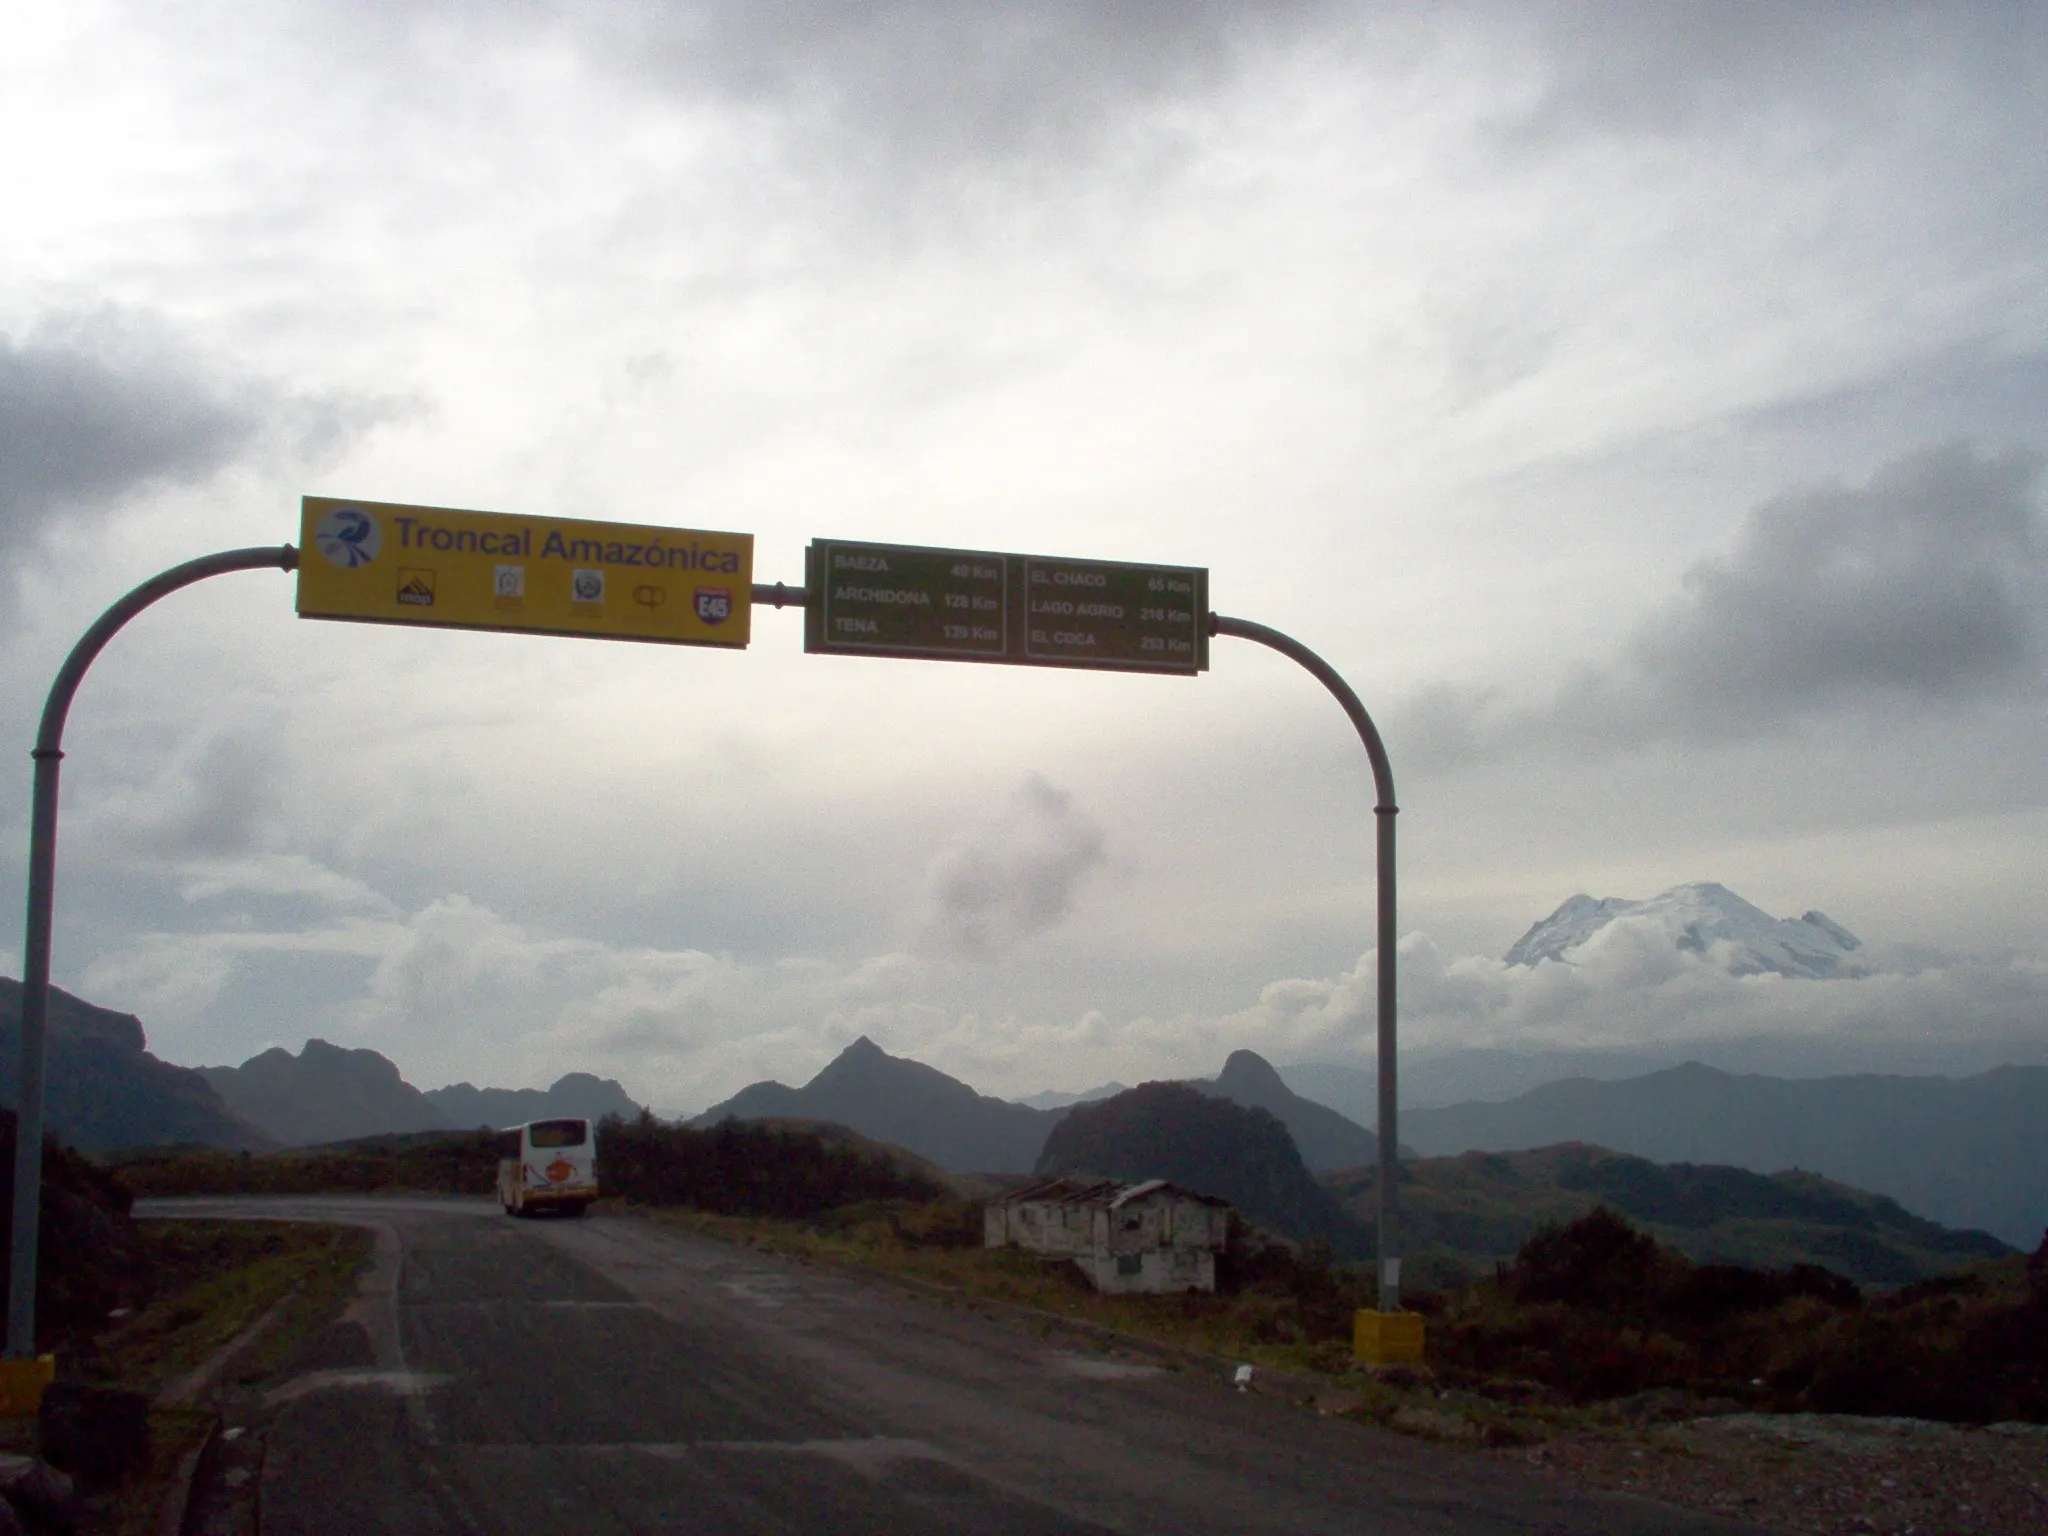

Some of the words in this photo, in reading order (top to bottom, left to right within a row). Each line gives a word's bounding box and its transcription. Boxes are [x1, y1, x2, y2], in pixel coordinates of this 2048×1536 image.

[394, 517, 531, 557] Troncal
[540, 527, 740, 574] Amazónica
[835, 555, 888, 572] BAEZA
[973, 566, 997, 581] Km
[1032, 570, 1049, 584] EL
[1054, 572, 1106, 587] CHACO
[1168, 580, 1190, 594] Km
[698, 596, 728, 617] E45
[835, 587, 930, 605] ARCHIDONA
[973, 596, 998, 611] Km
[1032, 600, 1073, 614] LAGO
[1077, 602, 1124, 618] AGRIO
[1168, 608, 1190, 622] Km
[835, 618, 878, 633] TENA
[973, 626, 998, 641] Km
[1032, 630, 1049, 644] EL
[1054, 631, 1096, 646] COCA
[1168, 637, 1190, 652] Km
